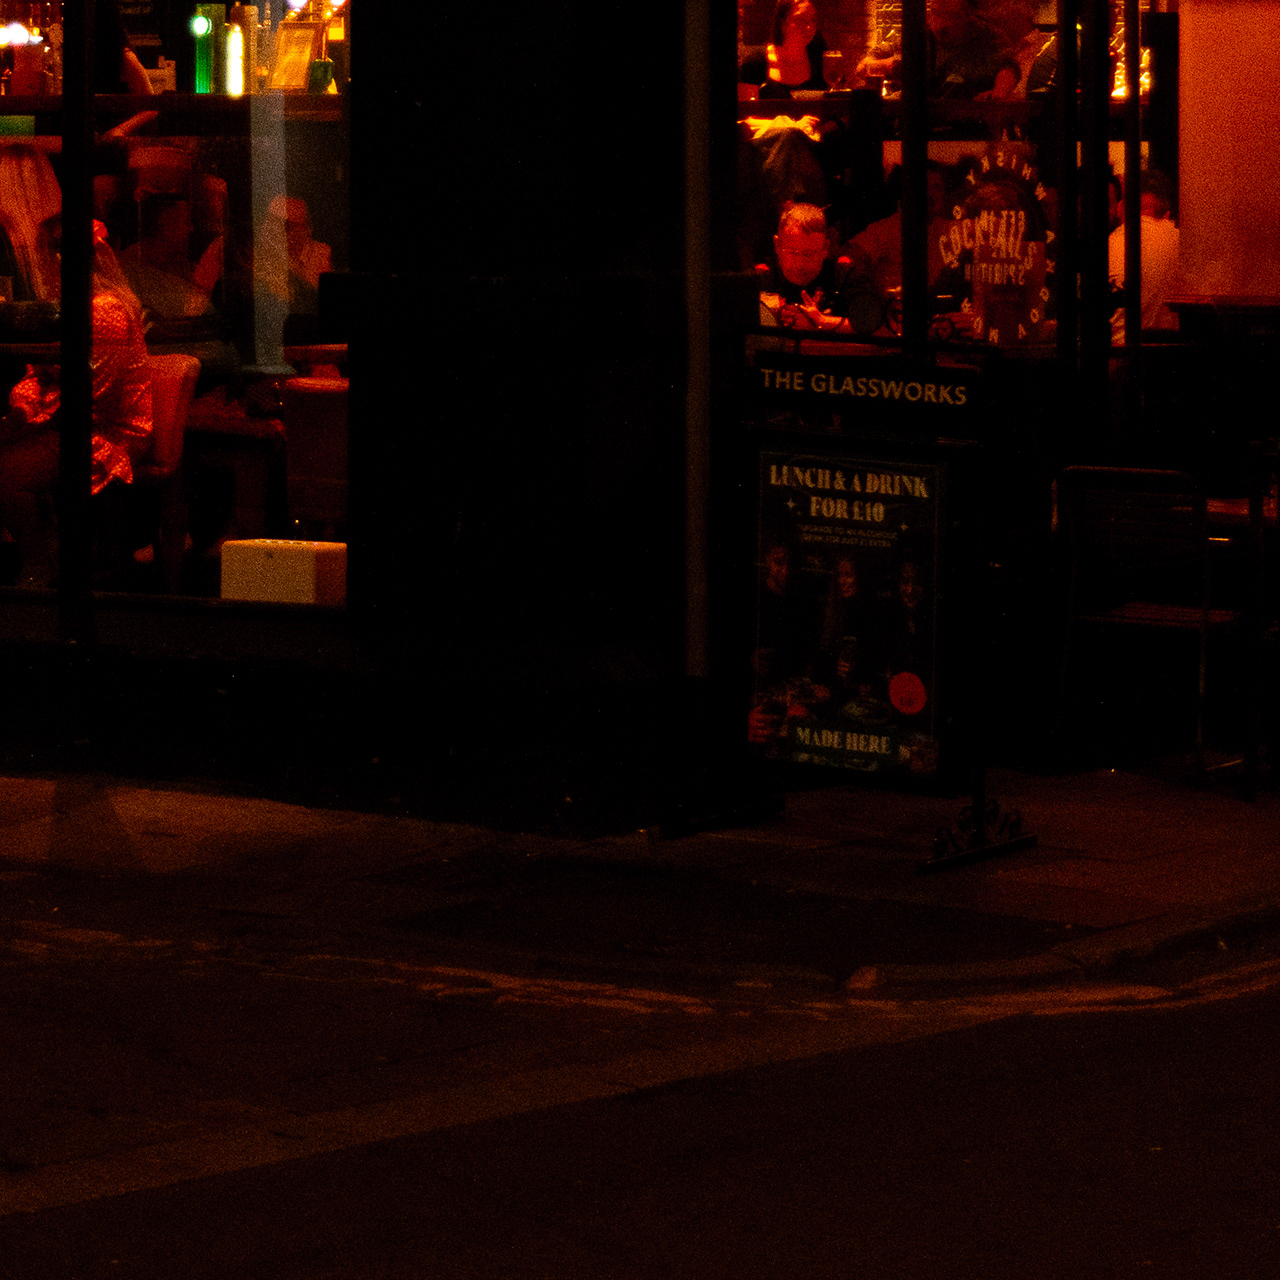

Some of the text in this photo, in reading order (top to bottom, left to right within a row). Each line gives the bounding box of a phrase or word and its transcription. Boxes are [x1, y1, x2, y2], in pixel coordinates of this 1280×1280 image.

[759, 368, 968, 406] THE GLASSWORKS
[769, 464, 929, 499] LUNCH & A DRINK
[810, 495, 886, 523] FOR £10
[796, 726, 891, 755] MADE HERE
